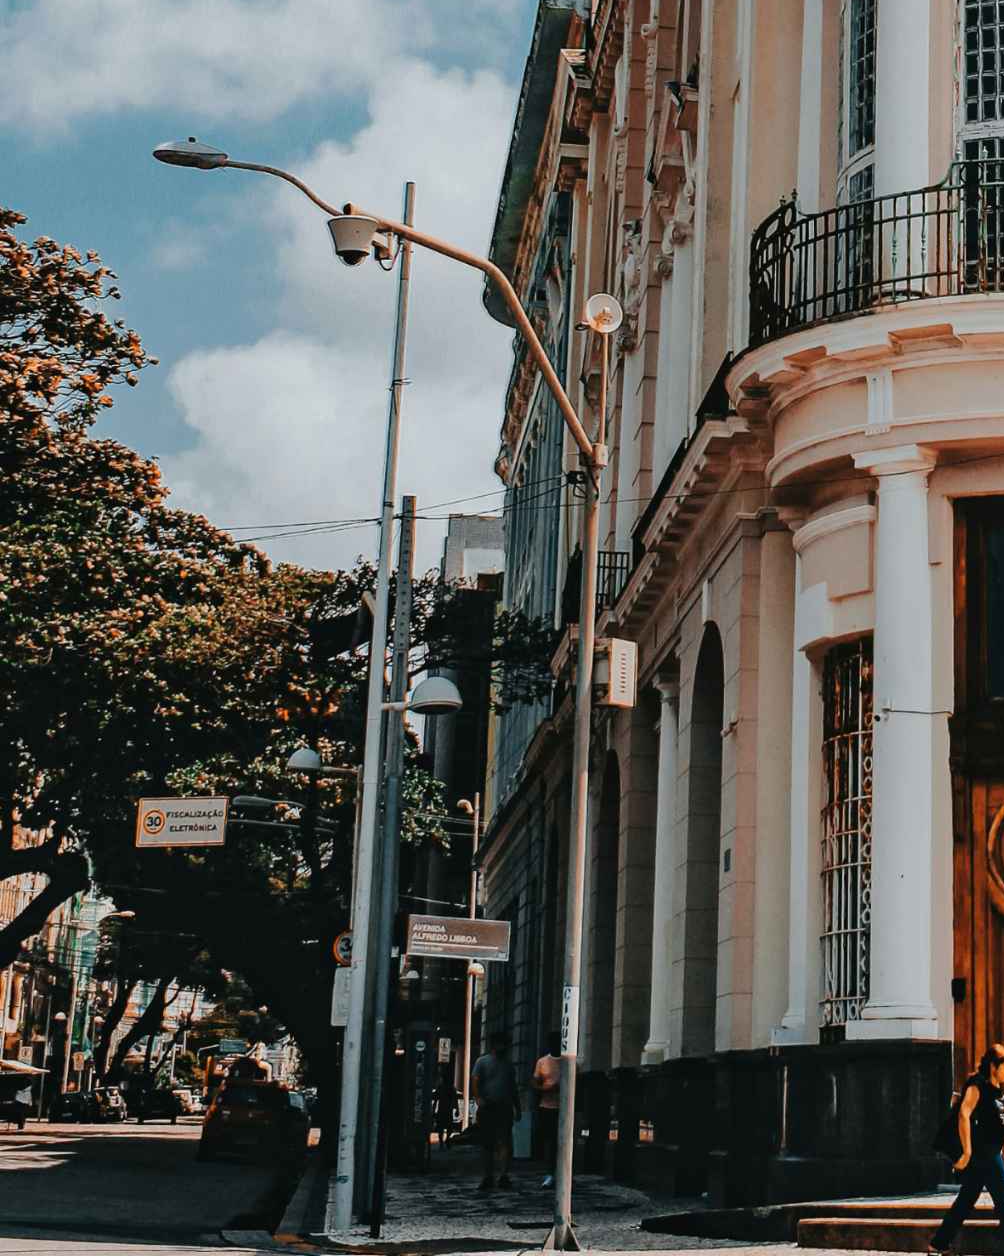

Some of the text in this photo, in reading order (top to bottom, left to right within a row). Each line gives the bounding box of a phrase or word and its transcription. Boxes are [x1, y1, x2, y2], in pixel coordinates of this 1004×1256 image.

[166, 809, 224, 819] FISCALIZAÇÃO
[146, 816, 161, 827] 30
[169, 824, 217, 833] ELETRÔNICA
[412, 924, 446, 933] AVENIDA
[411, 932, 478, 944] ALFREDO LISBOA
